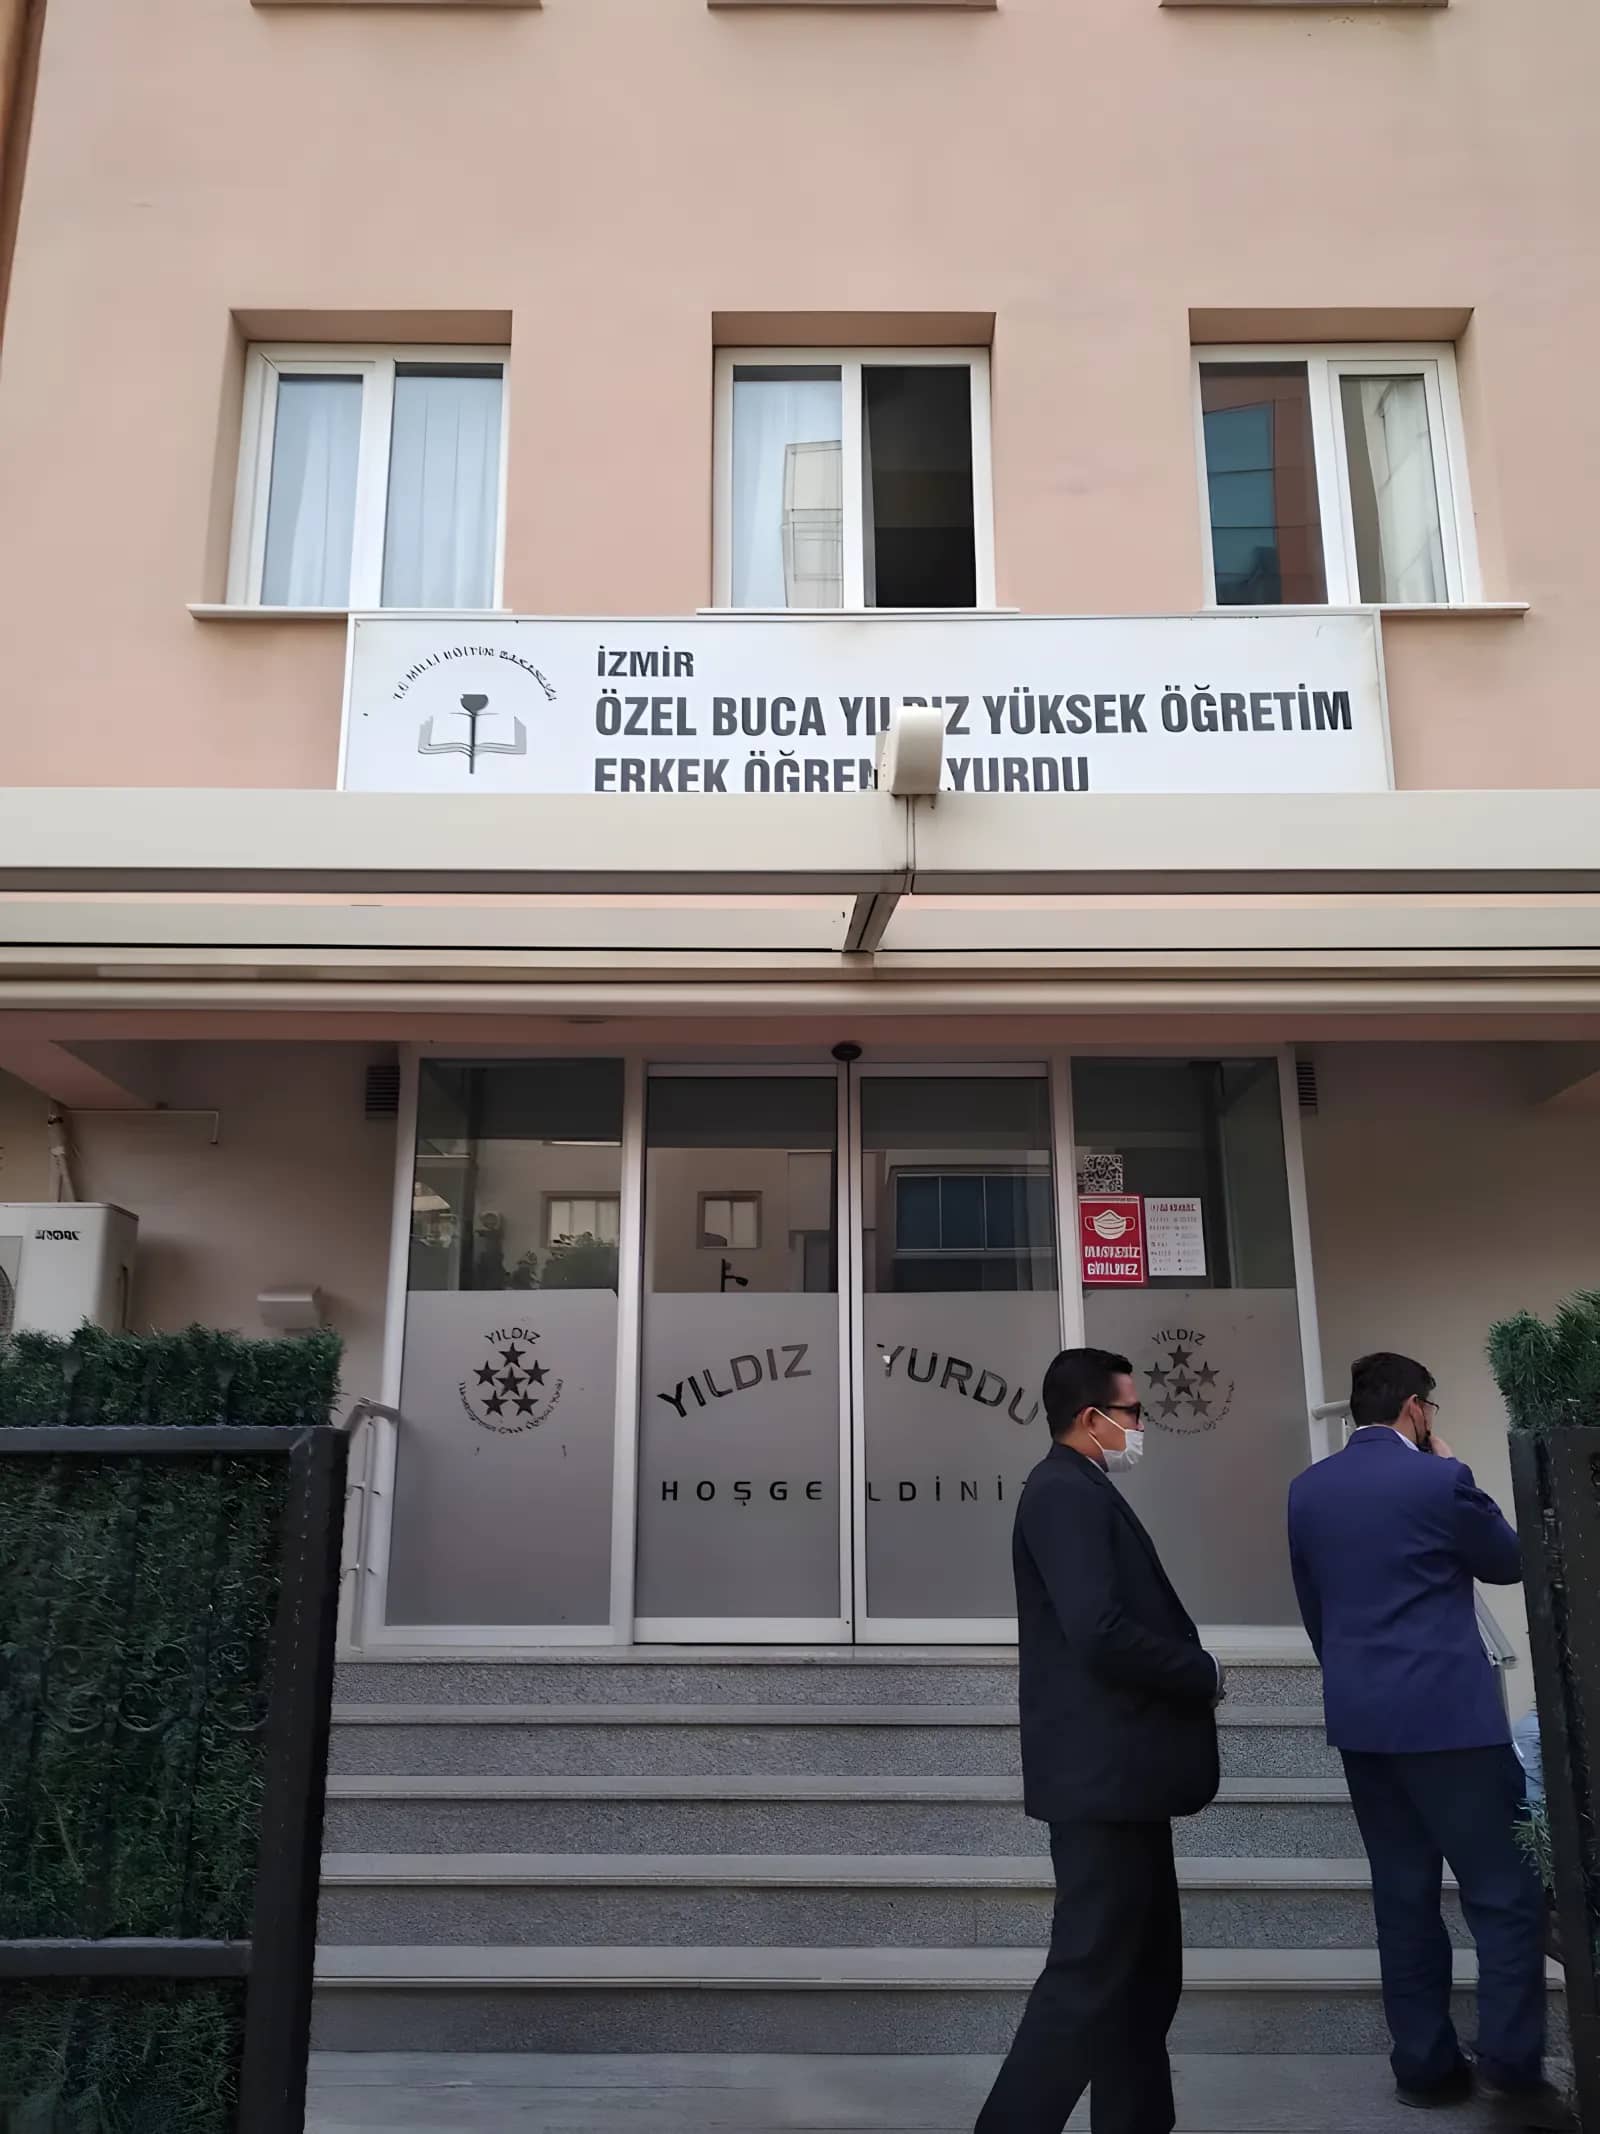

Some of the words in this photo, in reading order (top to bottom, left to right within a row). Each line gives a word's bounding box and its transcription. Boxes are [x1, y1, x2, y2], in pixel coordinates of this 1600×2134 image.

[597, 645, 695, 678] İZMİR
[595, 688, 697, 737] ÖZEL
[712, 696, 827, 737] BUCA
[982, 686, 1148, 736] YÜKSEK
[1160, 682, 1353, 734] ÖĞRETİM
[594, 757, 731, 793] ERKEK
[945, 756, 1089, 793] YURDU
[484, 1327, 541, 1345] YILDIZ
[1151, 1328, 1207, 1346] YILDIZ
[656, 1343, 812, 1418] YILDIZ
[876, 1343, 1040, 1426] YURDU
